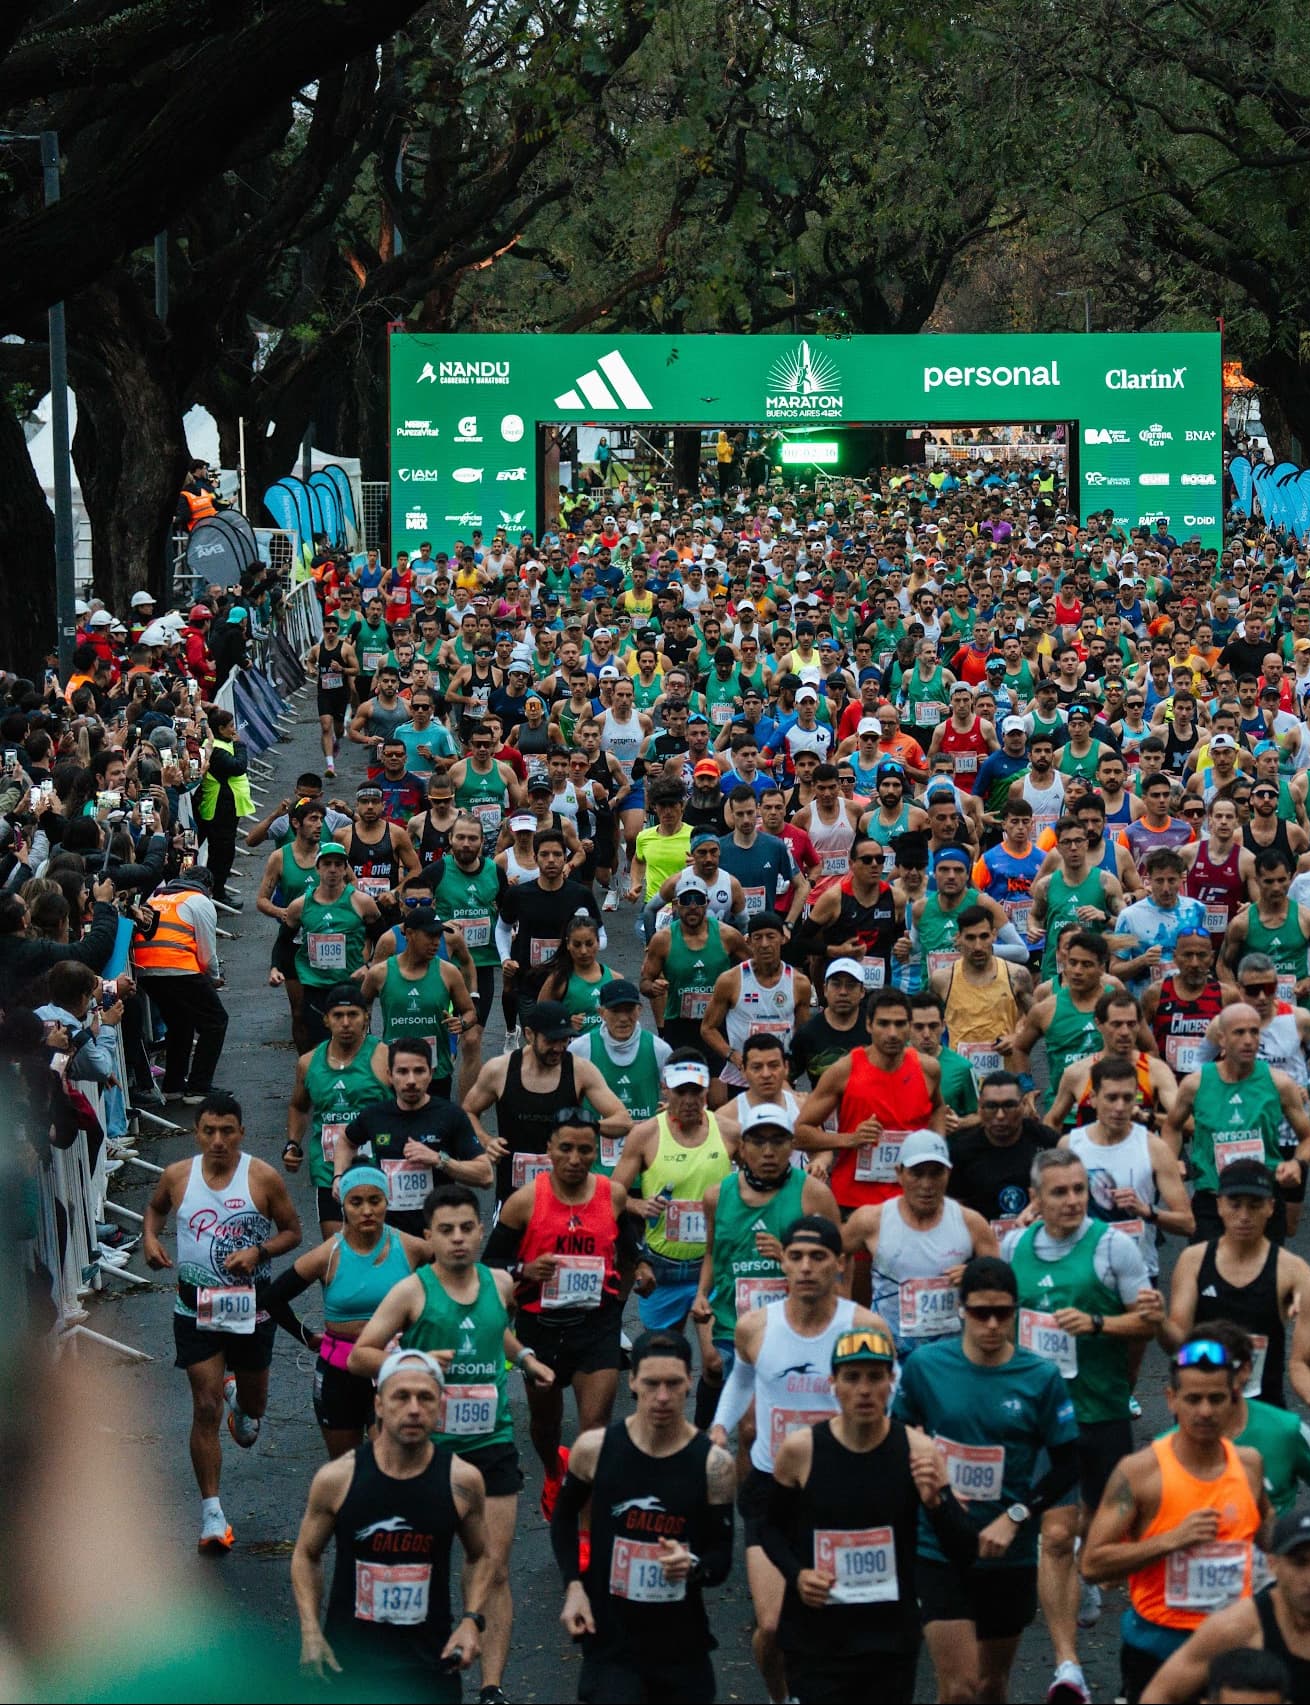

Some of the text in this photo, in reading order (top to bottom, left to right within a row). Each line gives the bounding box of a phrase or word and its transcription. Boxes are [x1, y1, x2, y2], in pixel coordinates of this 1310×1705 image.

[924, 361, 1060, 392] personal
[1105, 368, 1174, 389] Clarín
[766, 396, 843, 409] MARATON
[766, 409, 843, 417] BUENOS AIRES 42K
[320, 943, 342, 956] 1936
[391, 1014, 437, 1027] personal
[625, 1105, 651, 1118] onal
[879, 1145, 901, 1162] 157
[398, 1172, 427, 1190] 1288
[556, 1235, 595, 1256] KING
[733, 1259, 784, 1275] person
[219, 1295, 250, 1314] 1610
[787, 1374, 832, 1394] GALGO
[454, 1402, 490, 1424] 1596
[954, 1463, 995, 1488] 1089
[626, 1509, 687, 1534] GALGOS
[372, 1532, 434, 1553] GALGOS
[843, 1550, 887, 1576] 1090
[360, 1569, 423, 1610] C 1374
